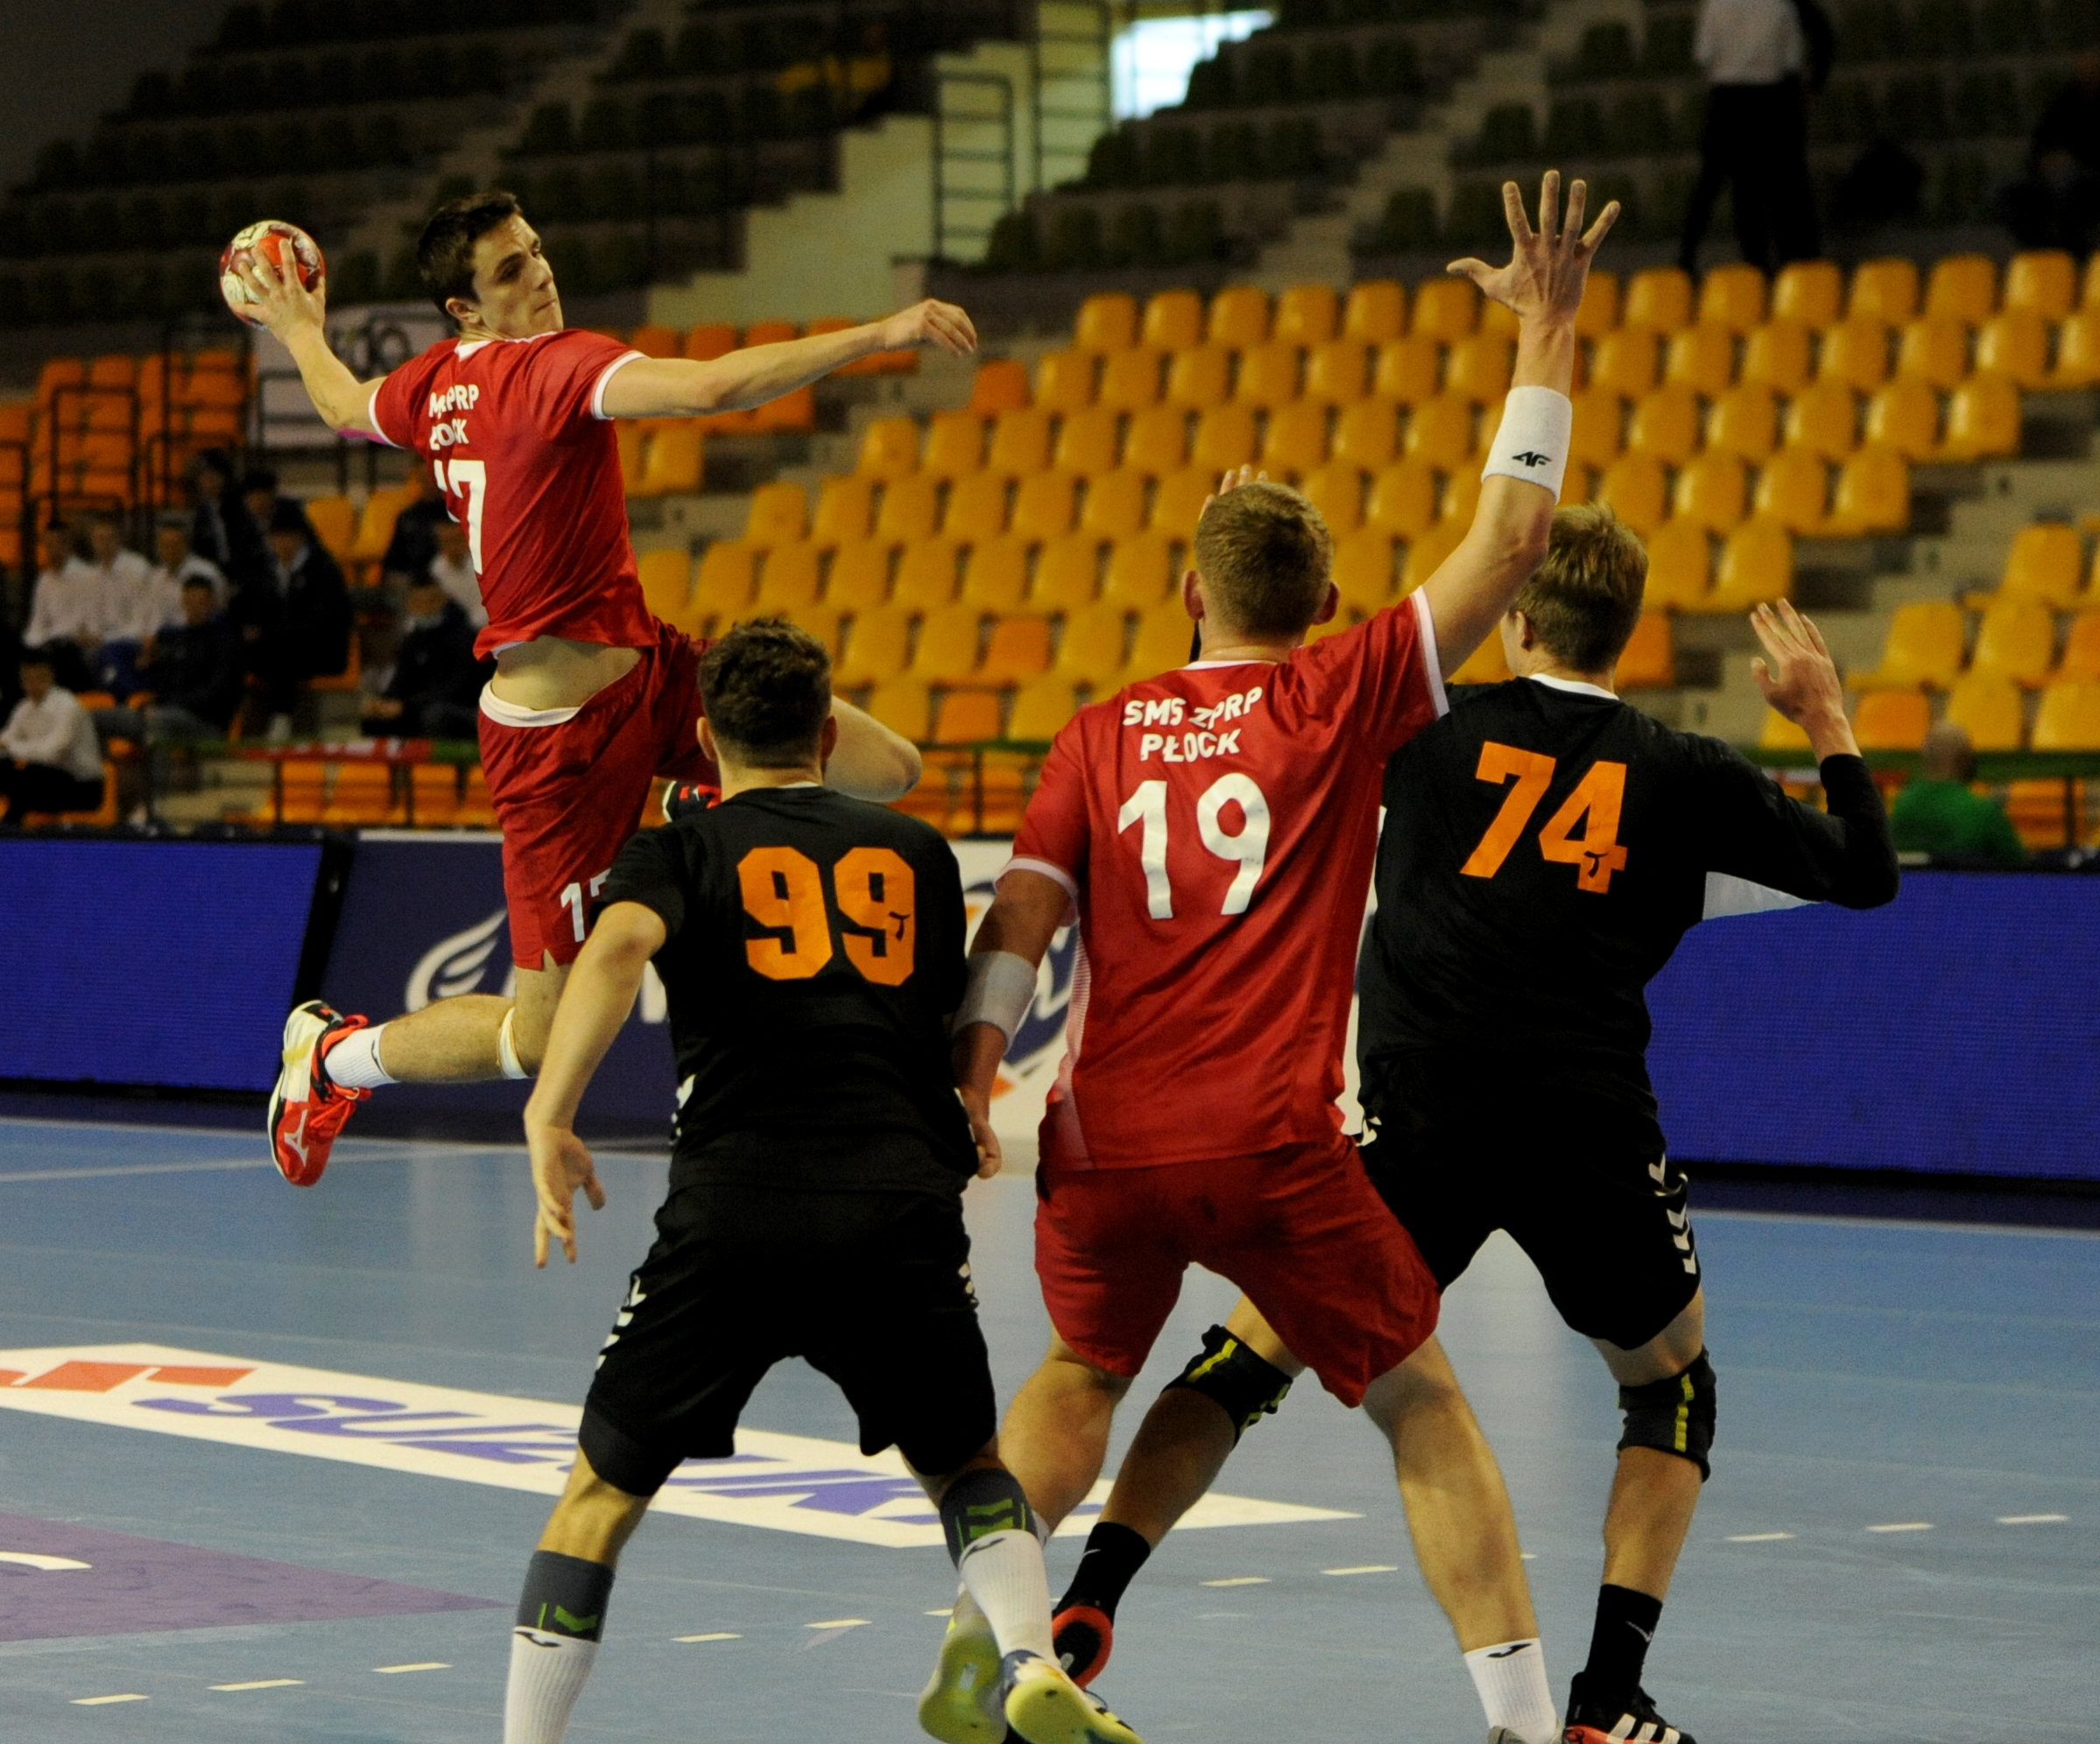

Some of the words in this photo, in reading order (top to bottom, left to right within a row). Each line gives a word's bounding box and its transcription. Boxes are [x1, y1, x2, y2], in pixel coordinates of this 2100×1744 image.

[1123, 698, 1187, 727] SMS
[1140, 728, 1241, 763] PŁOCK
[1118, 772, 1270, 918] 19
[1460, 741, 1628, 895] 74
[736, 847, 915, 987] 99
